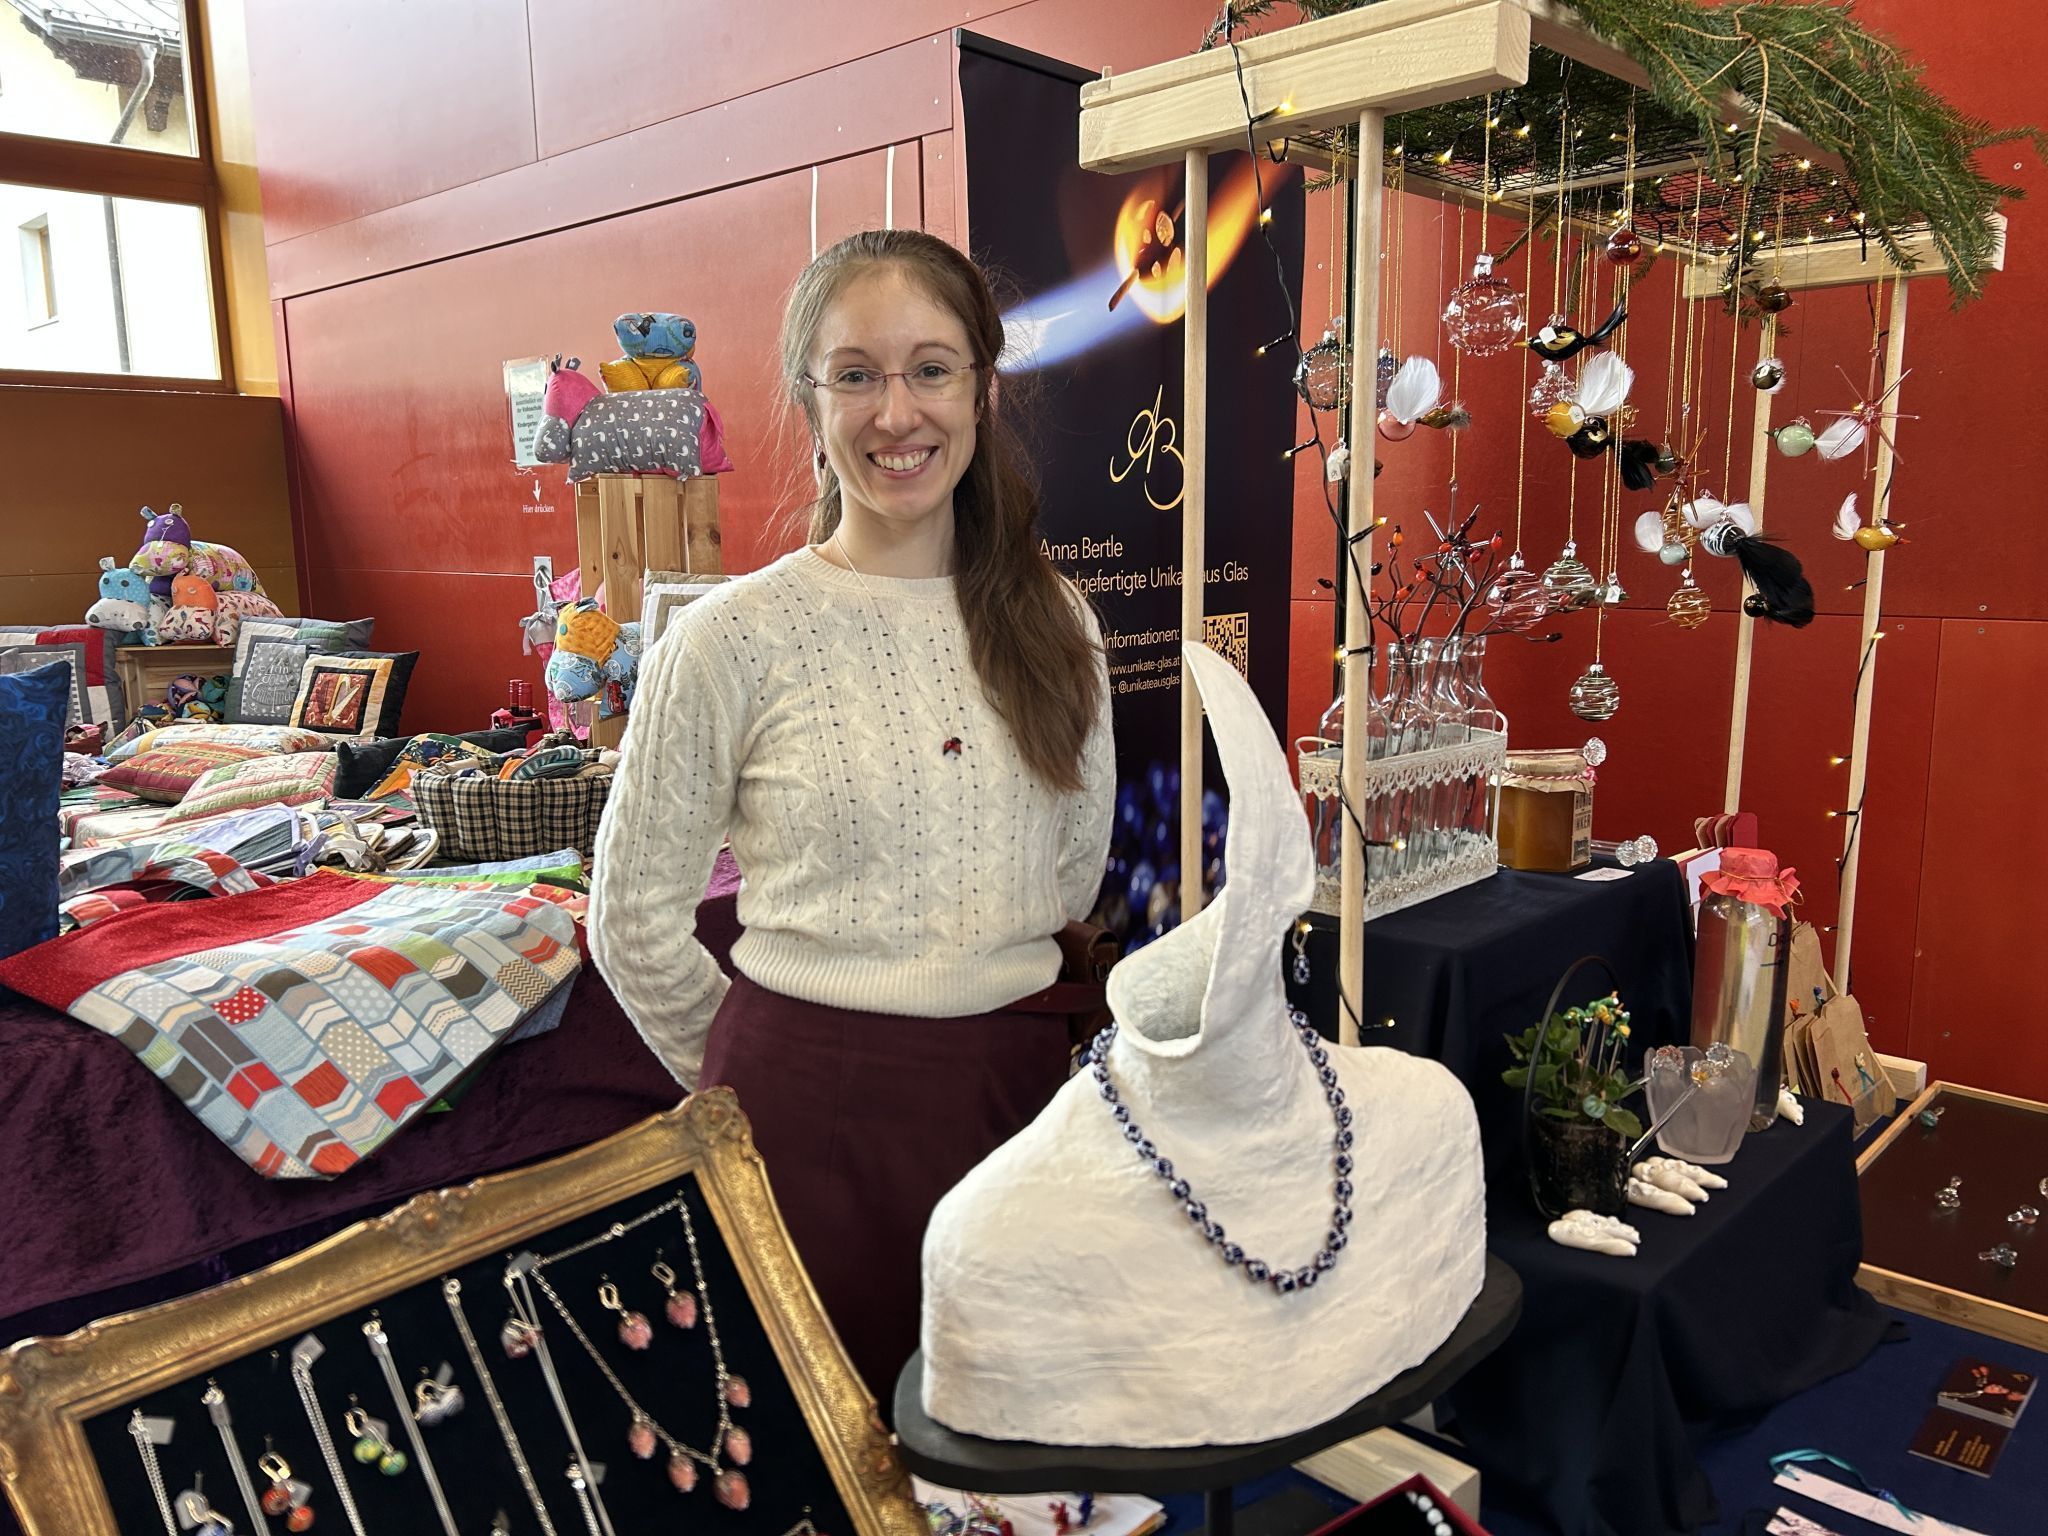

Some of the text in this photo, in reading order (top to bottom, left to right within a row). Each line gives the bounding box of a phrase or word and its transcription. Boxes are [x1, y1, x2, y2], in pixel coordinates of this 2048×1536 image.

[1040, 534, 1123, 560] Anna Bertle
[1071, 568, 1147, 600] dgefertigte
[1150, 564, 1183, 588] Unika
[1223, 561, 1249, 582] Glas
[1104, 627, 1180, 650] Informationen:
[1118, 672, 1181, 695] @unikateausglas
